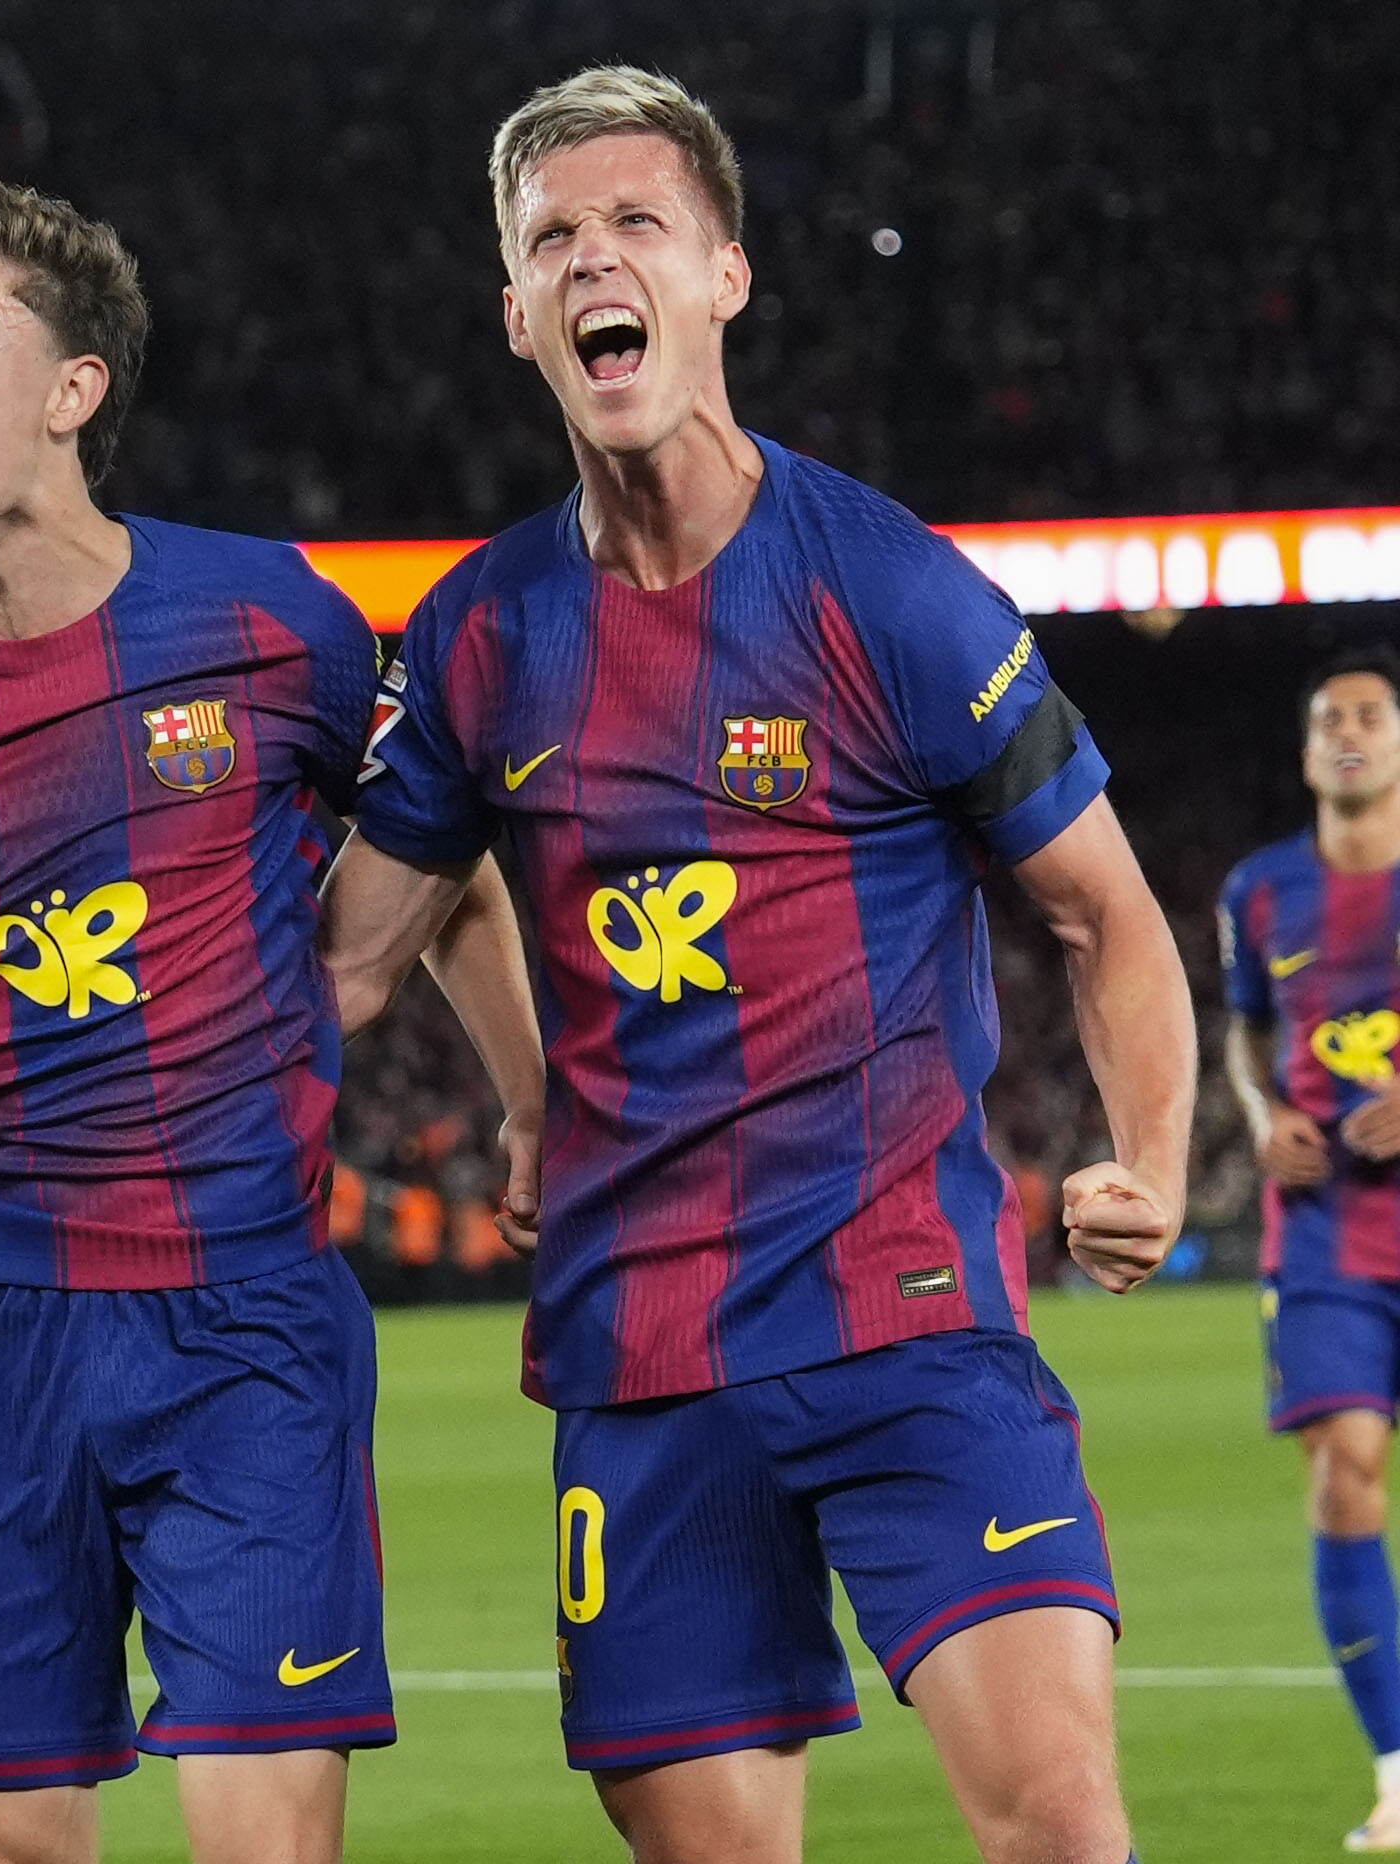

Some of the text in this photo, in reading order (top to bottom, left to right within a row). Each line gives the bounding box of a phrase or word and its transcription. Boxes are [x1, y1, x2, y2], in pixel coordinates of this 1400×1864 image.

[174, 737, 209, 753] FCB
[747, 755, 781, 767] FCB
[559, 1486, 605, 1624] 0
